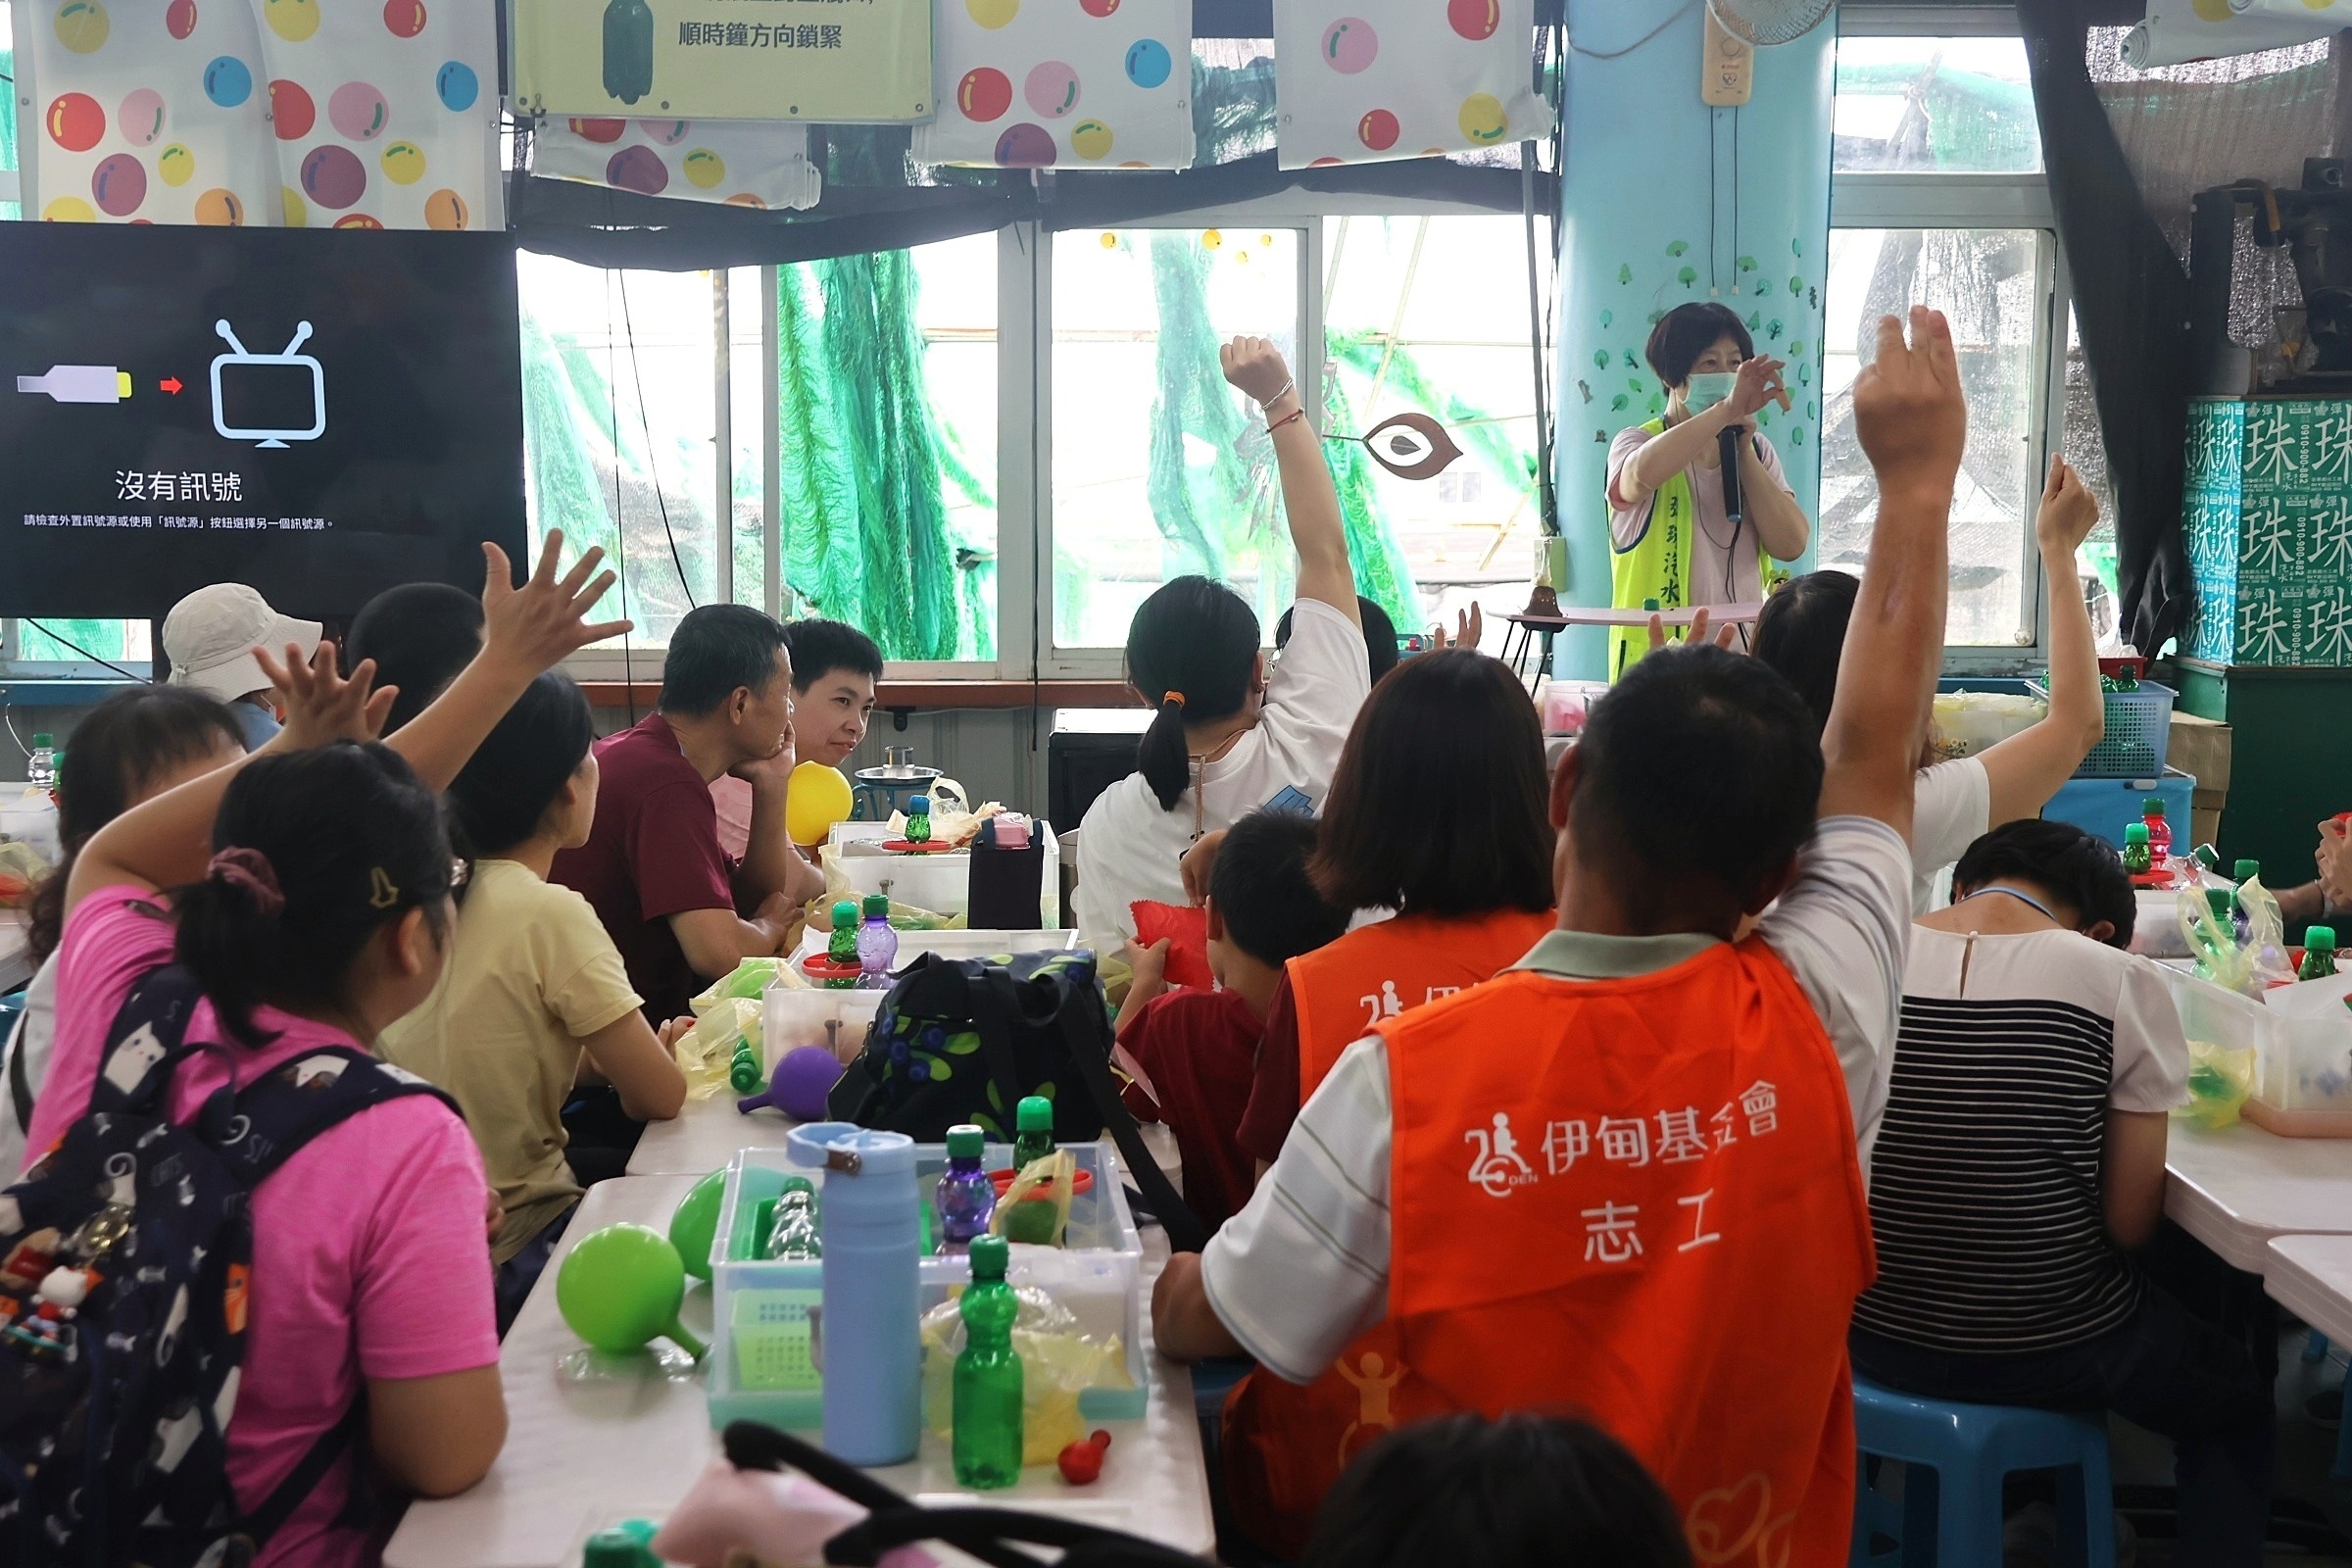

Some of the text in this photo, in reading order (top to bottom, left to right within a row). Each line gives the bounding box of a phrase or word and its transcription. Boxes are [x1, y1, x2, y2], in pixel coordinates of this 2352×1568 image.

[679, 22, 842, 49] 順時鐘方向鎖緊
[2243, 405, 2299, 486] 珠
[2299, 423, 2310, 484] 0910-900-882
[115, 469, 243, 502] 沒有訊號
[2239, 497, 2295, 577] 珠
[2295, 516, 2306, 576] 0910-900-882
[2236, 588, 2291, 666] 珠
[1541, 1080, 1778, 1176] 伊甸基金會
